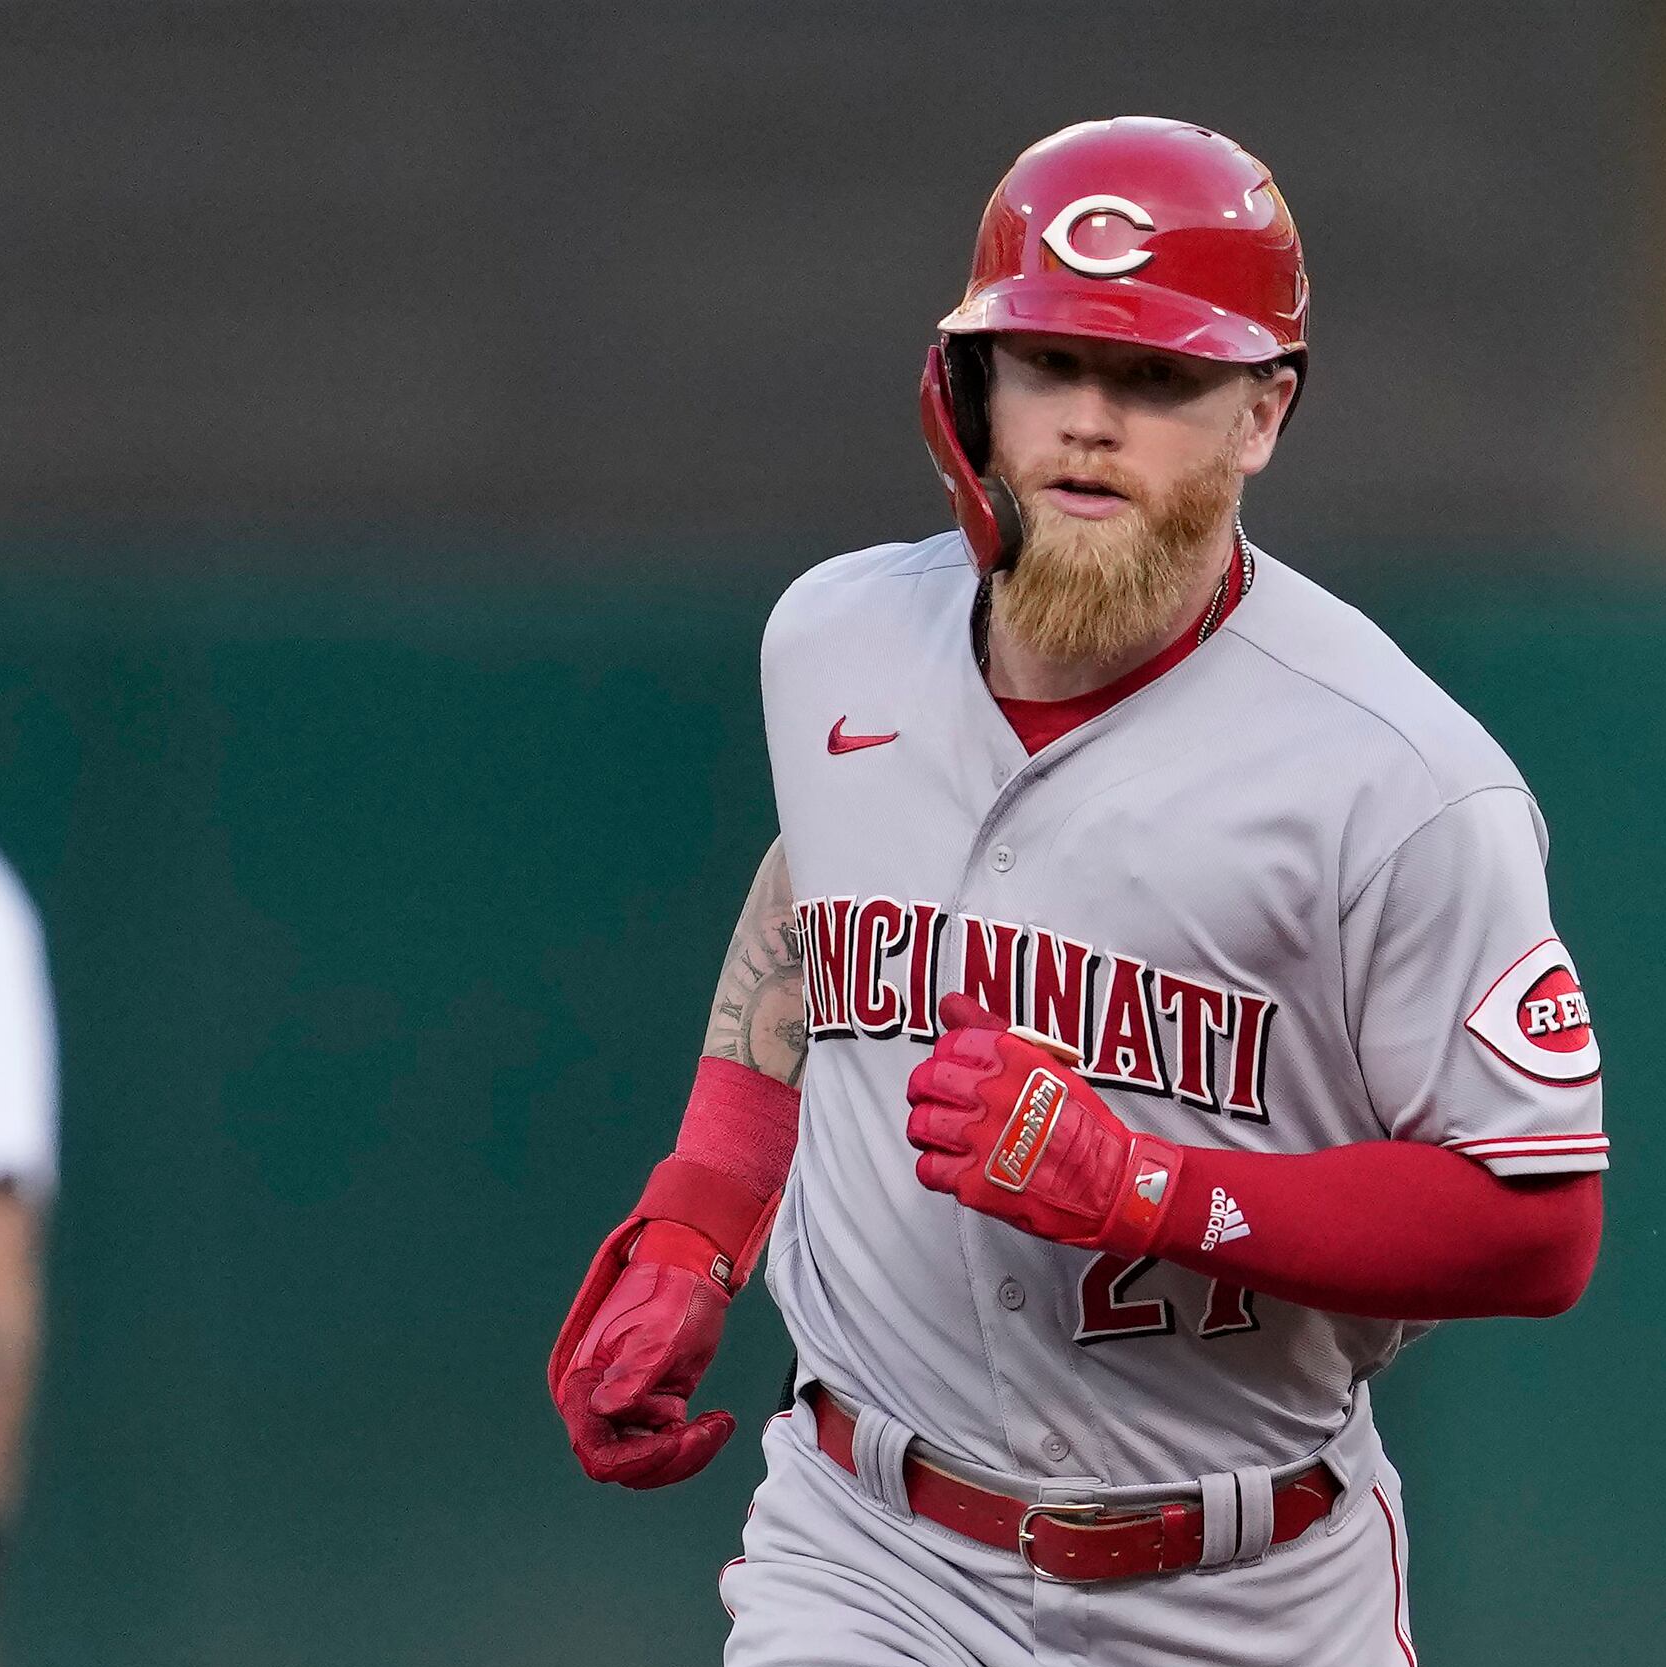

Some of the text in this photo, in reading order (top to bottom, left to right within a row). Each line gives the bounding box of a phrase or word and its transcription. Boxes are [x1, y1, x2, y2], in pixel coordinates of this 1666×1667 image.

[1042, 194, 1155, 278] C
[792, 895, 1278, 1125] INCINNATI
[1200, 1187, 1227, 1252] adidas
